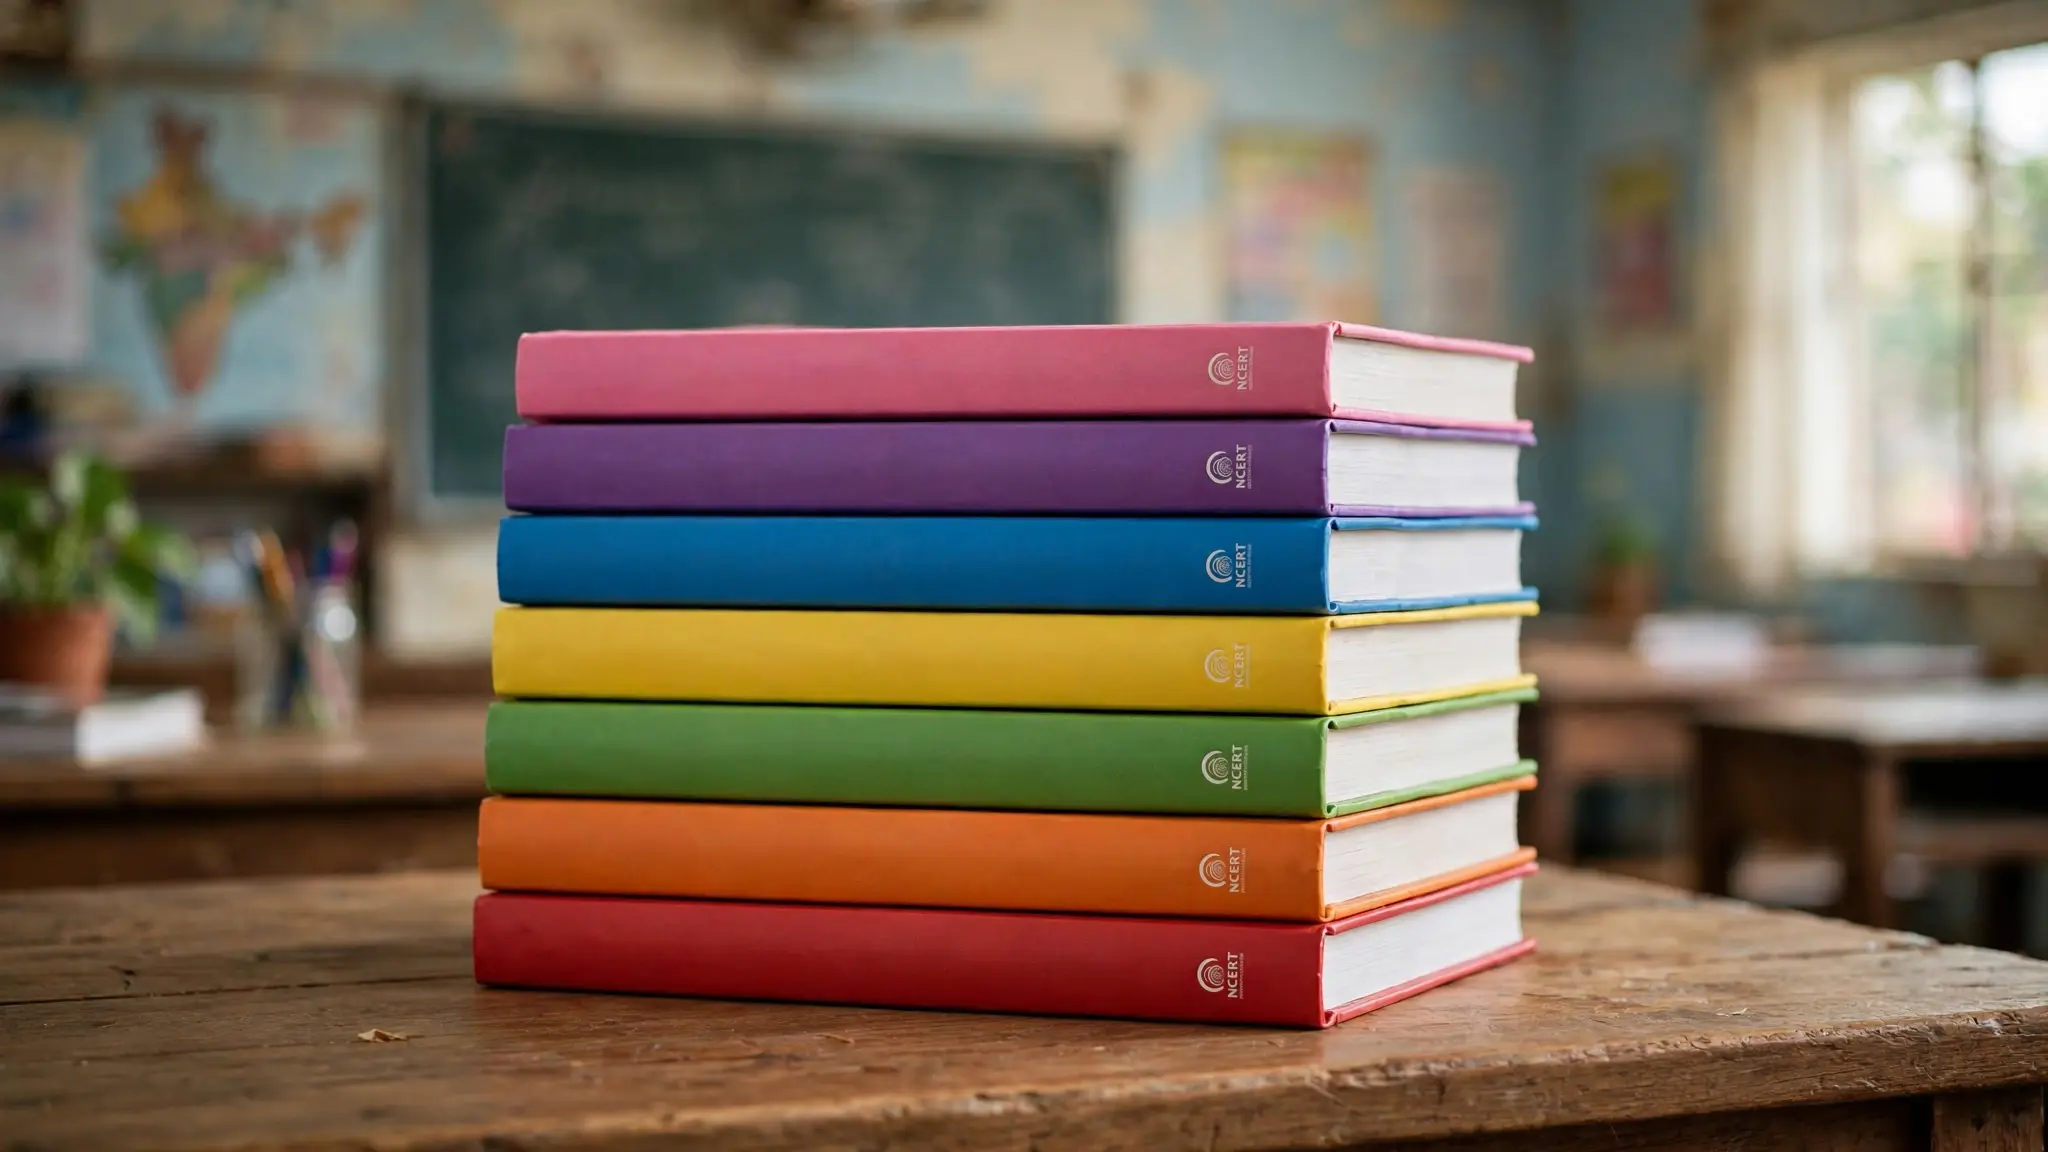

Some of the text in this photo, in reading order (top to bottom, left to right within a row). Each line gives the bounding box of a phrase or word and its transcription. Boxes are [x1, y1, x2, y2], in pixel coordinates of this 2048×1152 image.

[1237, 345, 1248, 390] NCERT
[1235, 444, 1247, 489] NCERT
[1235, 543, 1247, 587] NCERT
[1233, 643, 1245, 688] NCERT
[1231, 744, 1243, 789] NCERT
[1229, 847, 1240, 892] NCERT
[1227, 951, 1238, 998] NCERT
